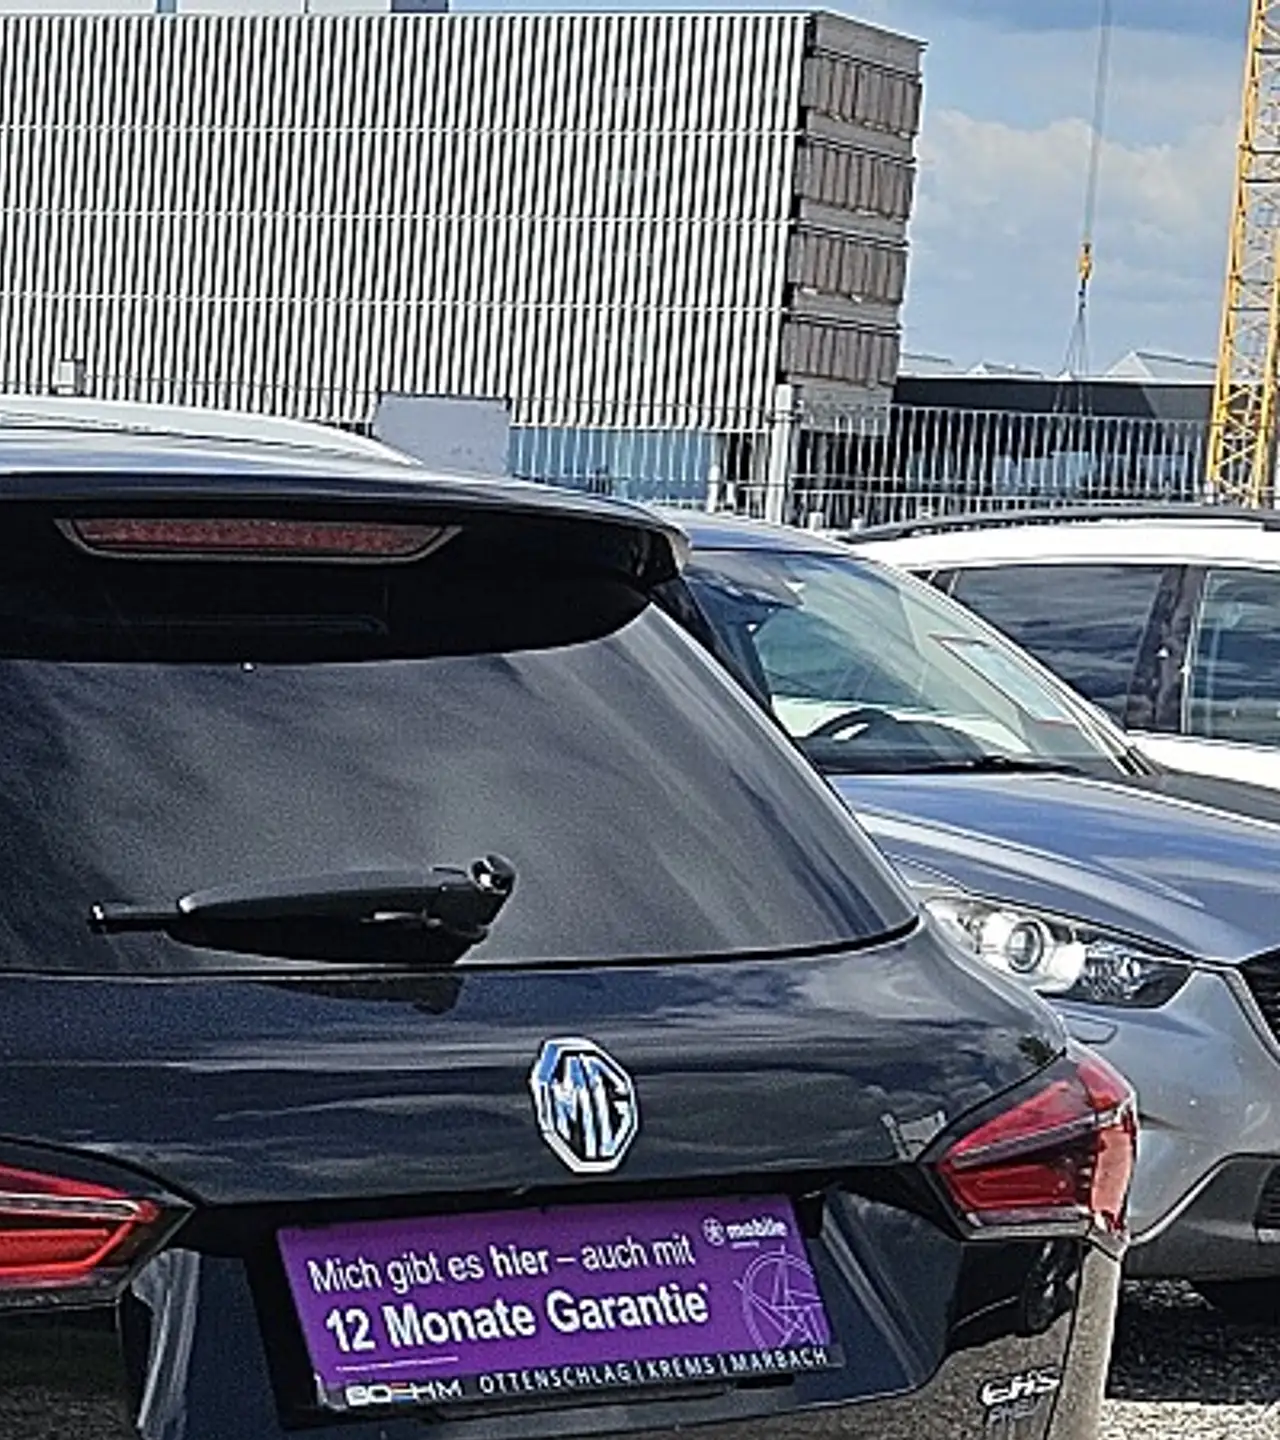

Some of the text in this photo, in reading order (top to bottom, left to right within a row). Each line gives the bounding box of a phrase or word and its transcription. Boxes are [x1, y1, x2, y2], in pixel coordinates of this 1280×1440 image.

[551, 1053, 630, 1158] MG
[726, 1216, 788, 1238] mobile
[306, 1257, 383, 1293] Mich
[386, 1250, 444, 1294] gibt
[447, 1254, 485, 1281] es
[489, 1244, 549, 1278] hier
[581, 1236, 649, 1270] auch
[652, 1230, 696, 1267] mit
[325, 1309, 376, 1352] 12
[381, 1298, 536, 1349] Monate
[478, 1362, 630, 1395] OTTENSCHLAG
[648, 1354, 715, 1380] KREMS
[730, 1347, 828, 1372] MARBACH
